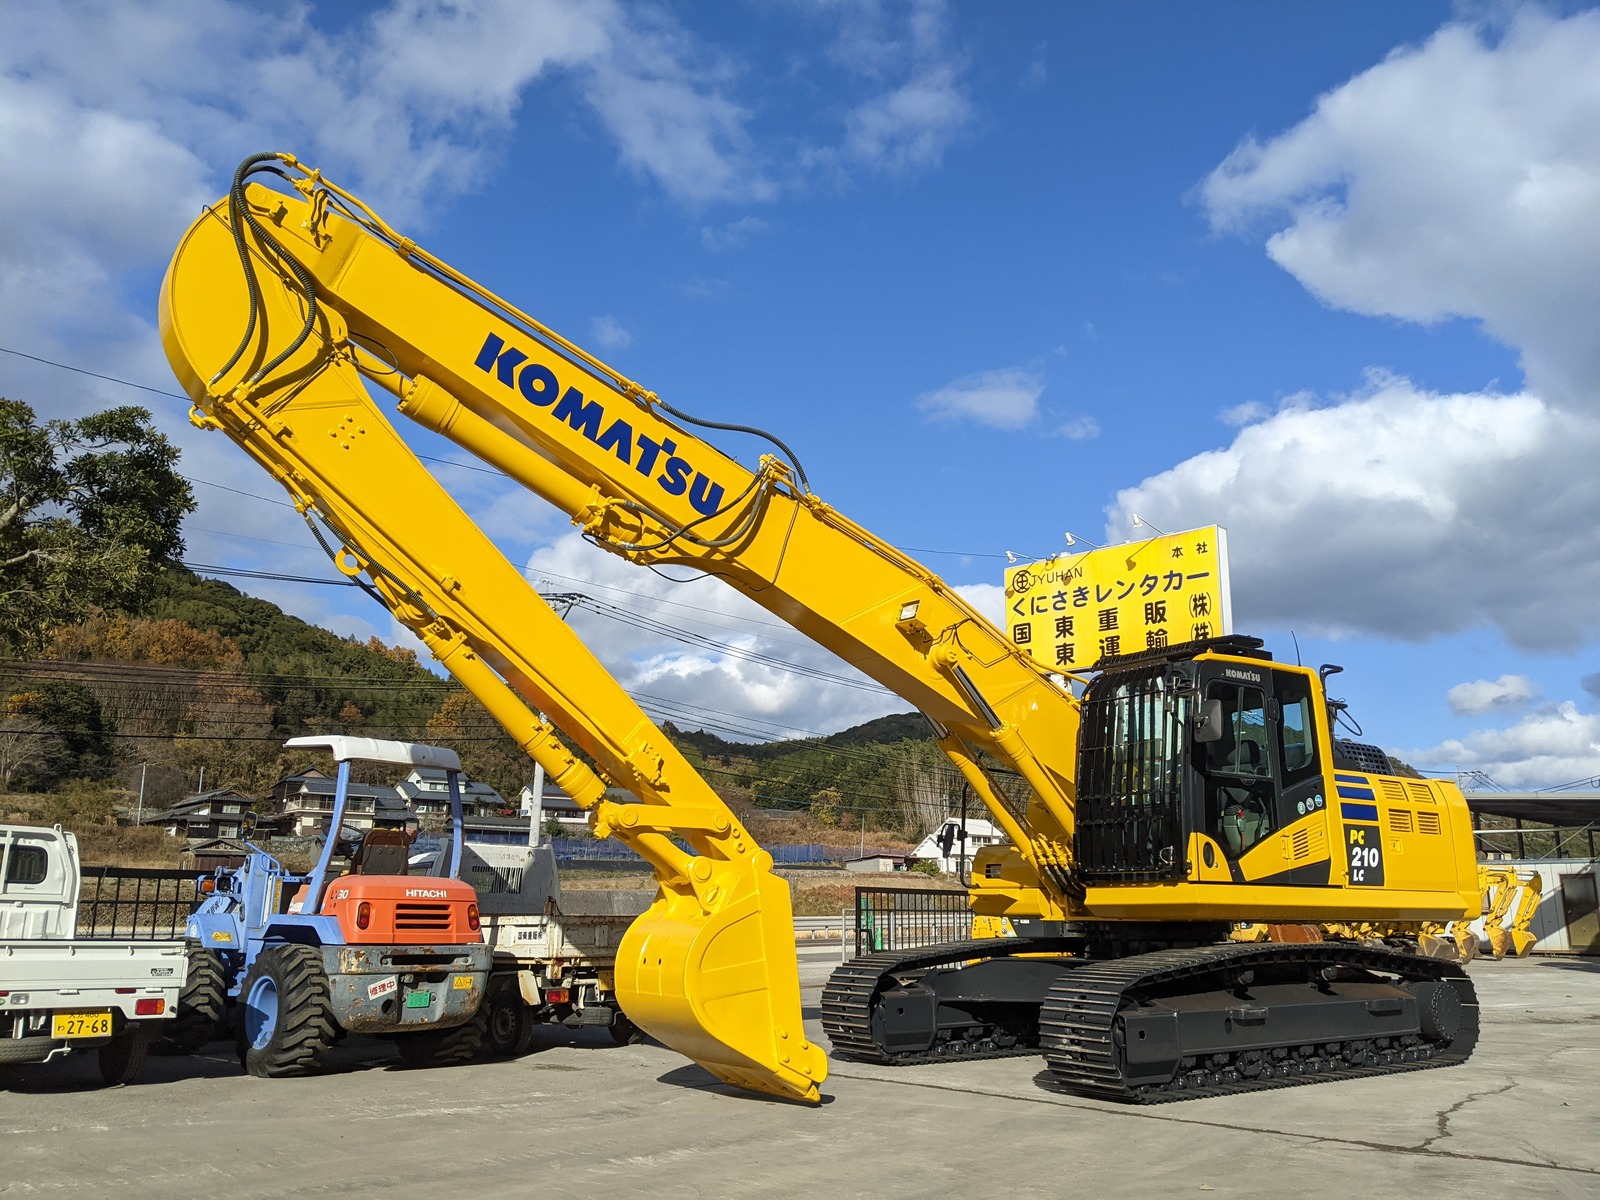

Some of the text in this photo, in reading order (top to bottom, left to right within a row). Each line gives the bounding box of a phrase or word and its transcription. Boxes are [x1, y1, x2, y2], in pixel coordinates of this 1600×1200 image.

[474, 332, 725, 516] KOMATSU
[1171, 541, 1208, 559] 本社
[1012, 570, 1210, 617] くにさきレンタカー
[1225, 668, 1260, 682] KOMATSU
[1350, 830, 1365, 845] PC
[1351, 847, 1379, 867] 210
[1353, 869, 1364, 881] LC
[405, 889, 447, 898] HITACHI
[369, 980, 395, 996] 修理中
[67, 1019, 108, 1035] 27-68
